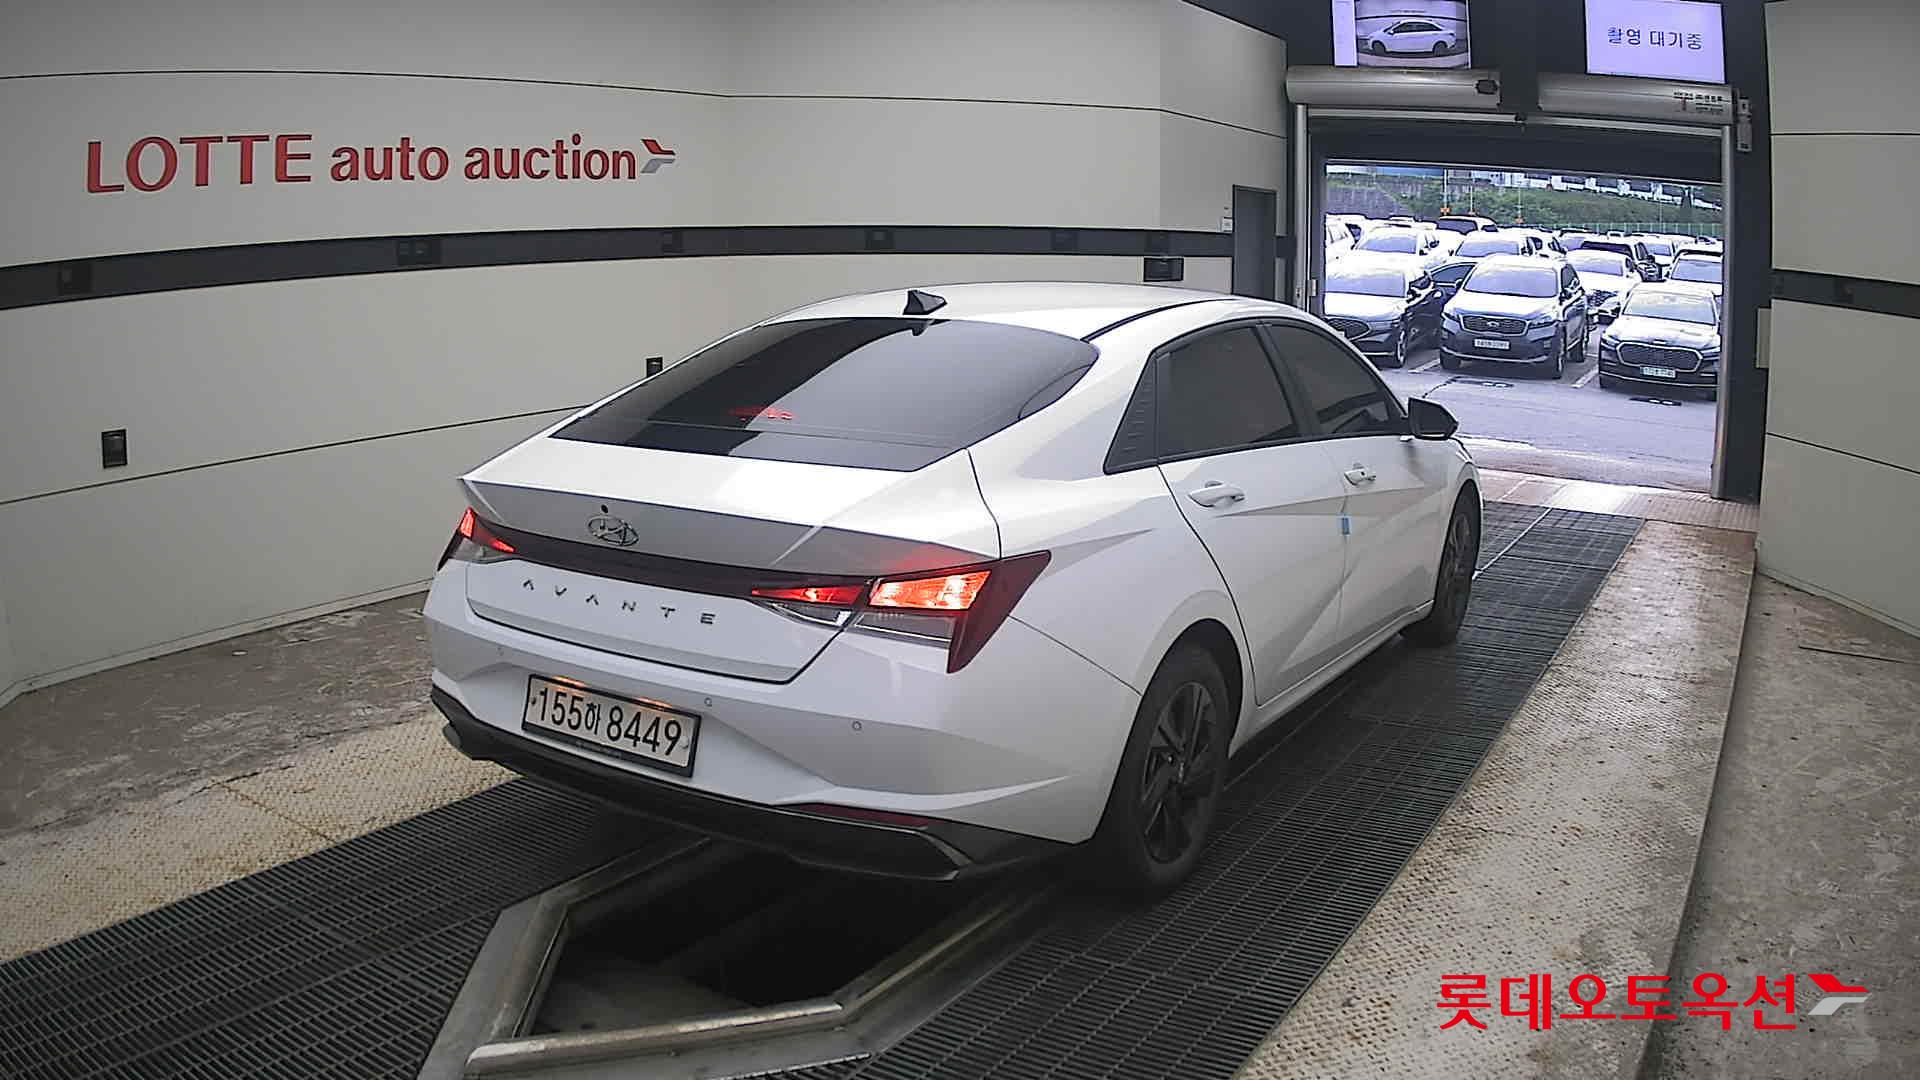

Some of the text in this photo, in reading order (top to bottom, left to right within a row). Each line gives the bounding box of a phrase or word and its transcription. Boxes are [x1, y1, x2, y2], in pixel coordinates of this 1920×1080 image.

[1649, 30, 1702, 51] 대기중
[86, 132, 637, 194] LOTTE auto auction
[522, 578, 716, 625] AVANTE
